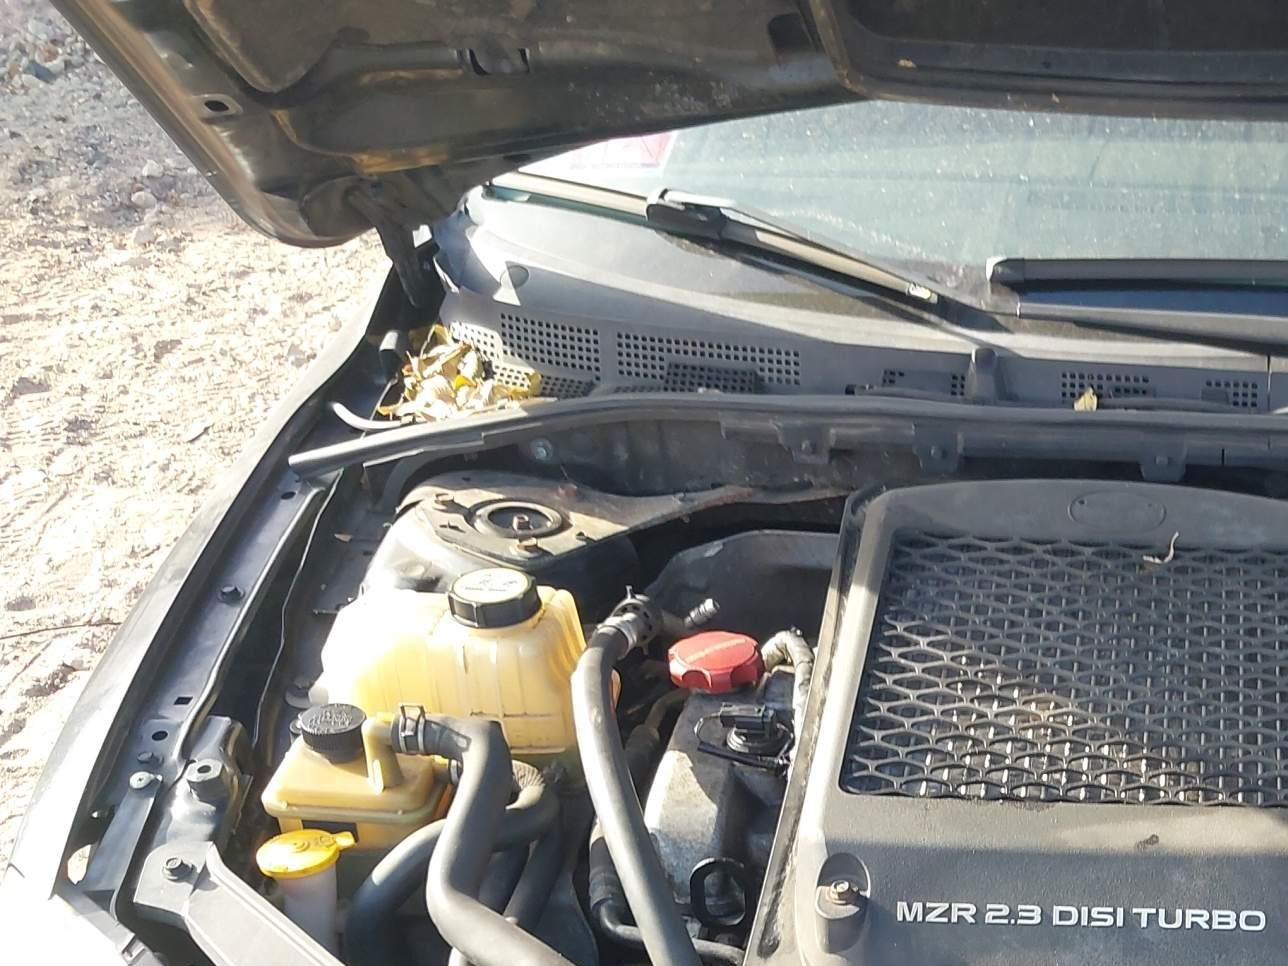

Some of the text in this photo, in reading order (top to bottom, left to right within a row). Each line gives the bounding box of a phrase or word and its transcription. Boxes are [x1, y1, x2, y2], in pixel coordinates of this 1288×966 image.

[896, 901, 1267, 931] MZR 2.3 DISI TURBO
